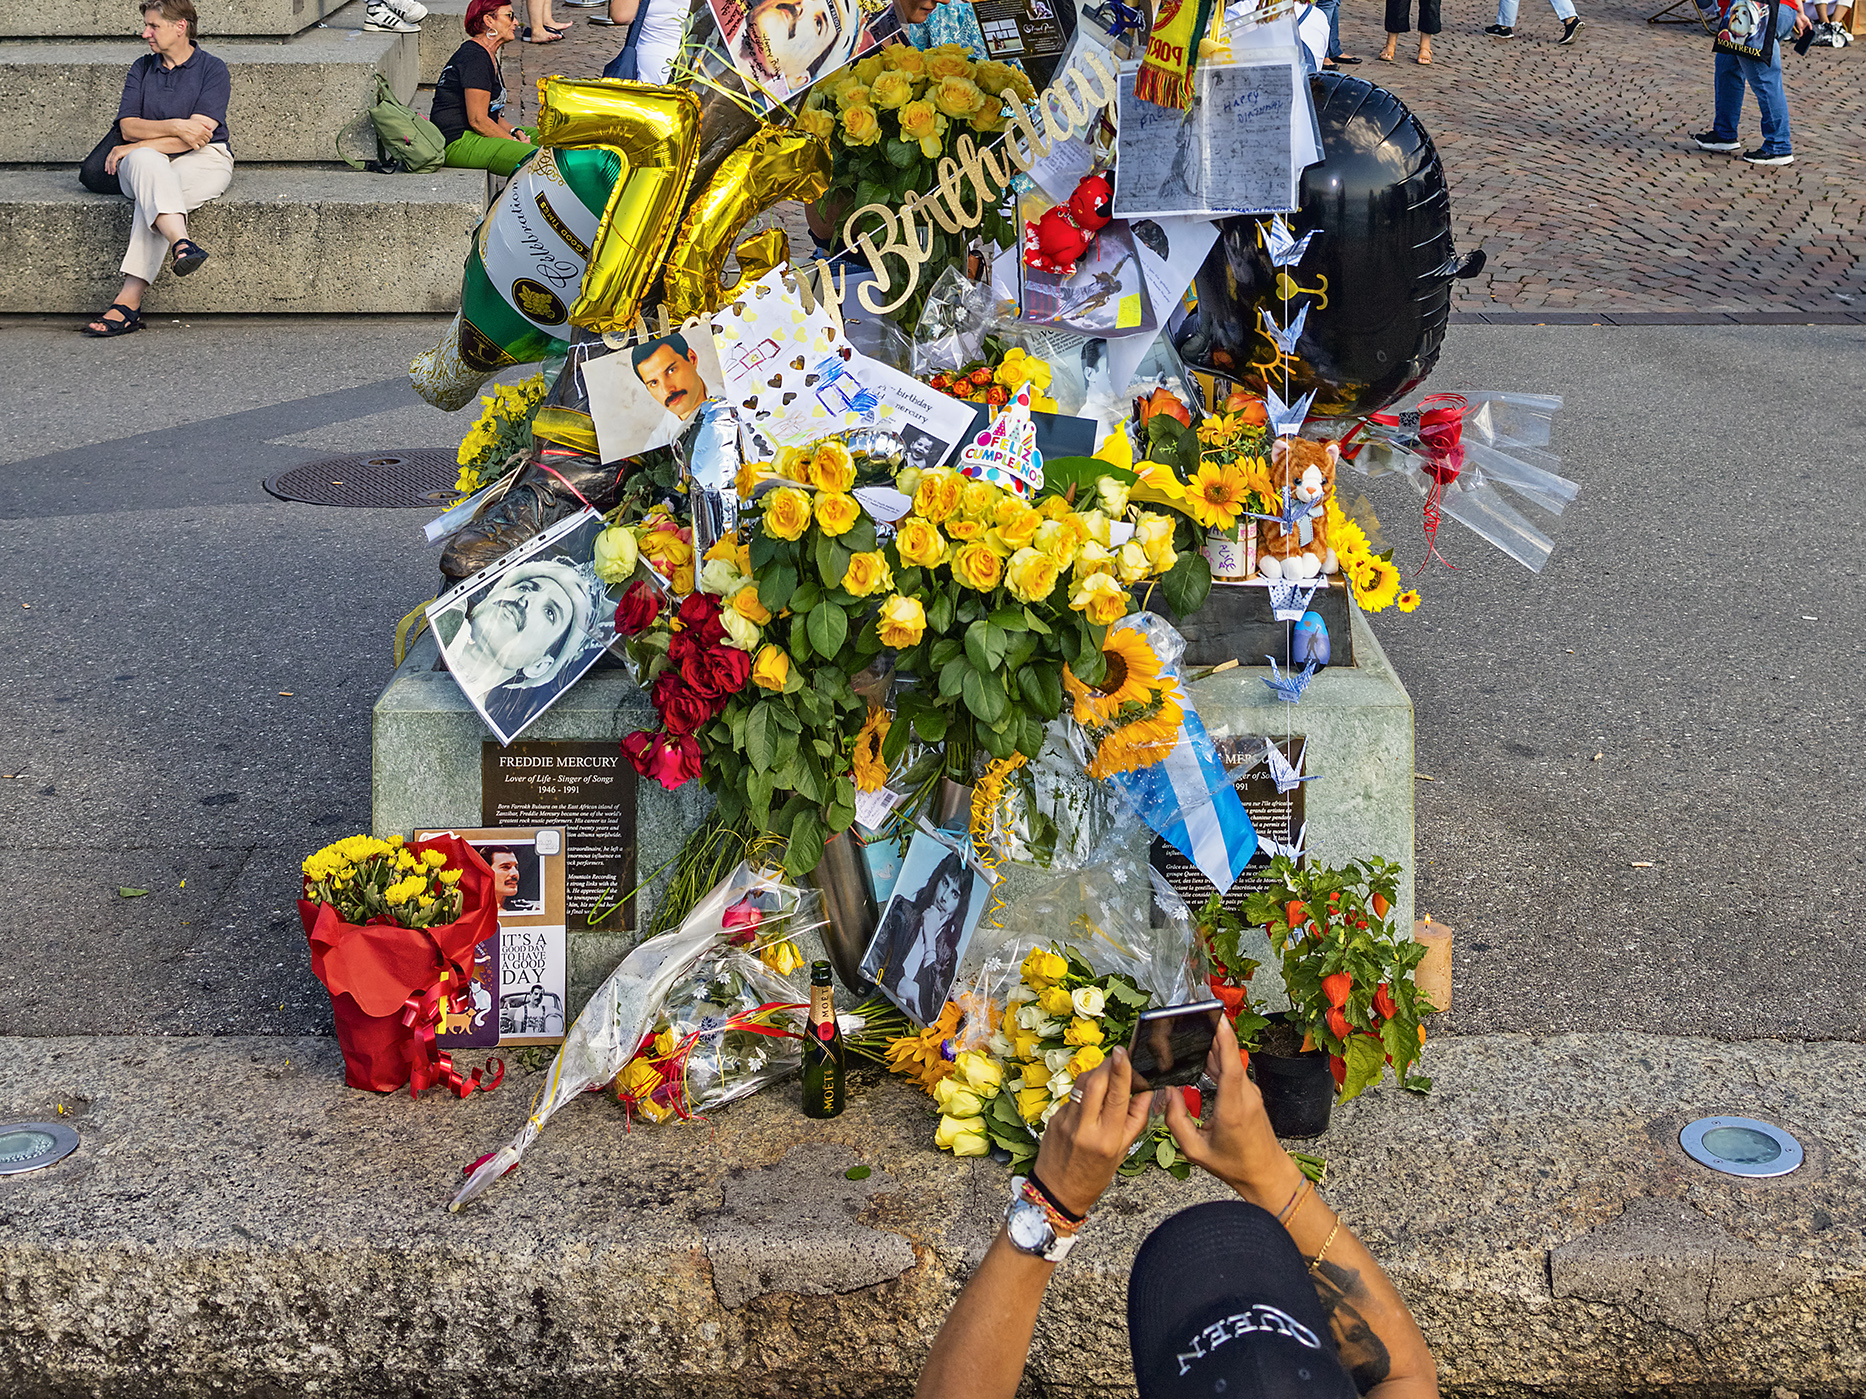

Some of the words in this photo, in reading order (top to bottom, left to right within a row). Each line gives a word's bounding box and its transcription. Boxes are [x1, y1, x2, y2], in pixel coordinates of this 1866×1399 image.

[1717, 37, 1762, 57] MONTREUX
[843, 51, 1121, 315] Birthday
[539, 201, 560, 229] TIMES
[560, 229, 584, 254] GOOD
[896, 387, 933, 412] birthday
[991, 435, 1032, 463] FELIZ
[966, 448, 1042, 485] CUMPLEAÑOS
[499, 756, 554, 768] FREDDIE
[556, 756, 619, 768] MERCURY
[505, 774, 526, 783] Lover
[527, 775, 536, 784] of
[537, 774, 551, 784] Life
[557, 774, 582, 784] Singer
[583, 775, 592, 784] of
[592, 774, 614, 784] Songs
[538, 786, 556, 794] 1946
[563, 786, 580, 794] 1991
[501, 945, 526, 953] GOOD
[528, 944, 546, 952] DAY
[502, 932, 532, 947] IT'S
[535, 933, 547, 945] A
[501, 952, 516, 962] TO
[518, 951, 547, 961] HAVE
[501, 961, 510, 970] A
[512, 959, 546, 970] GOOD
[502, 968, 546, 985] DAY
[1176, 1303, 1322, 1376] QUEEN
